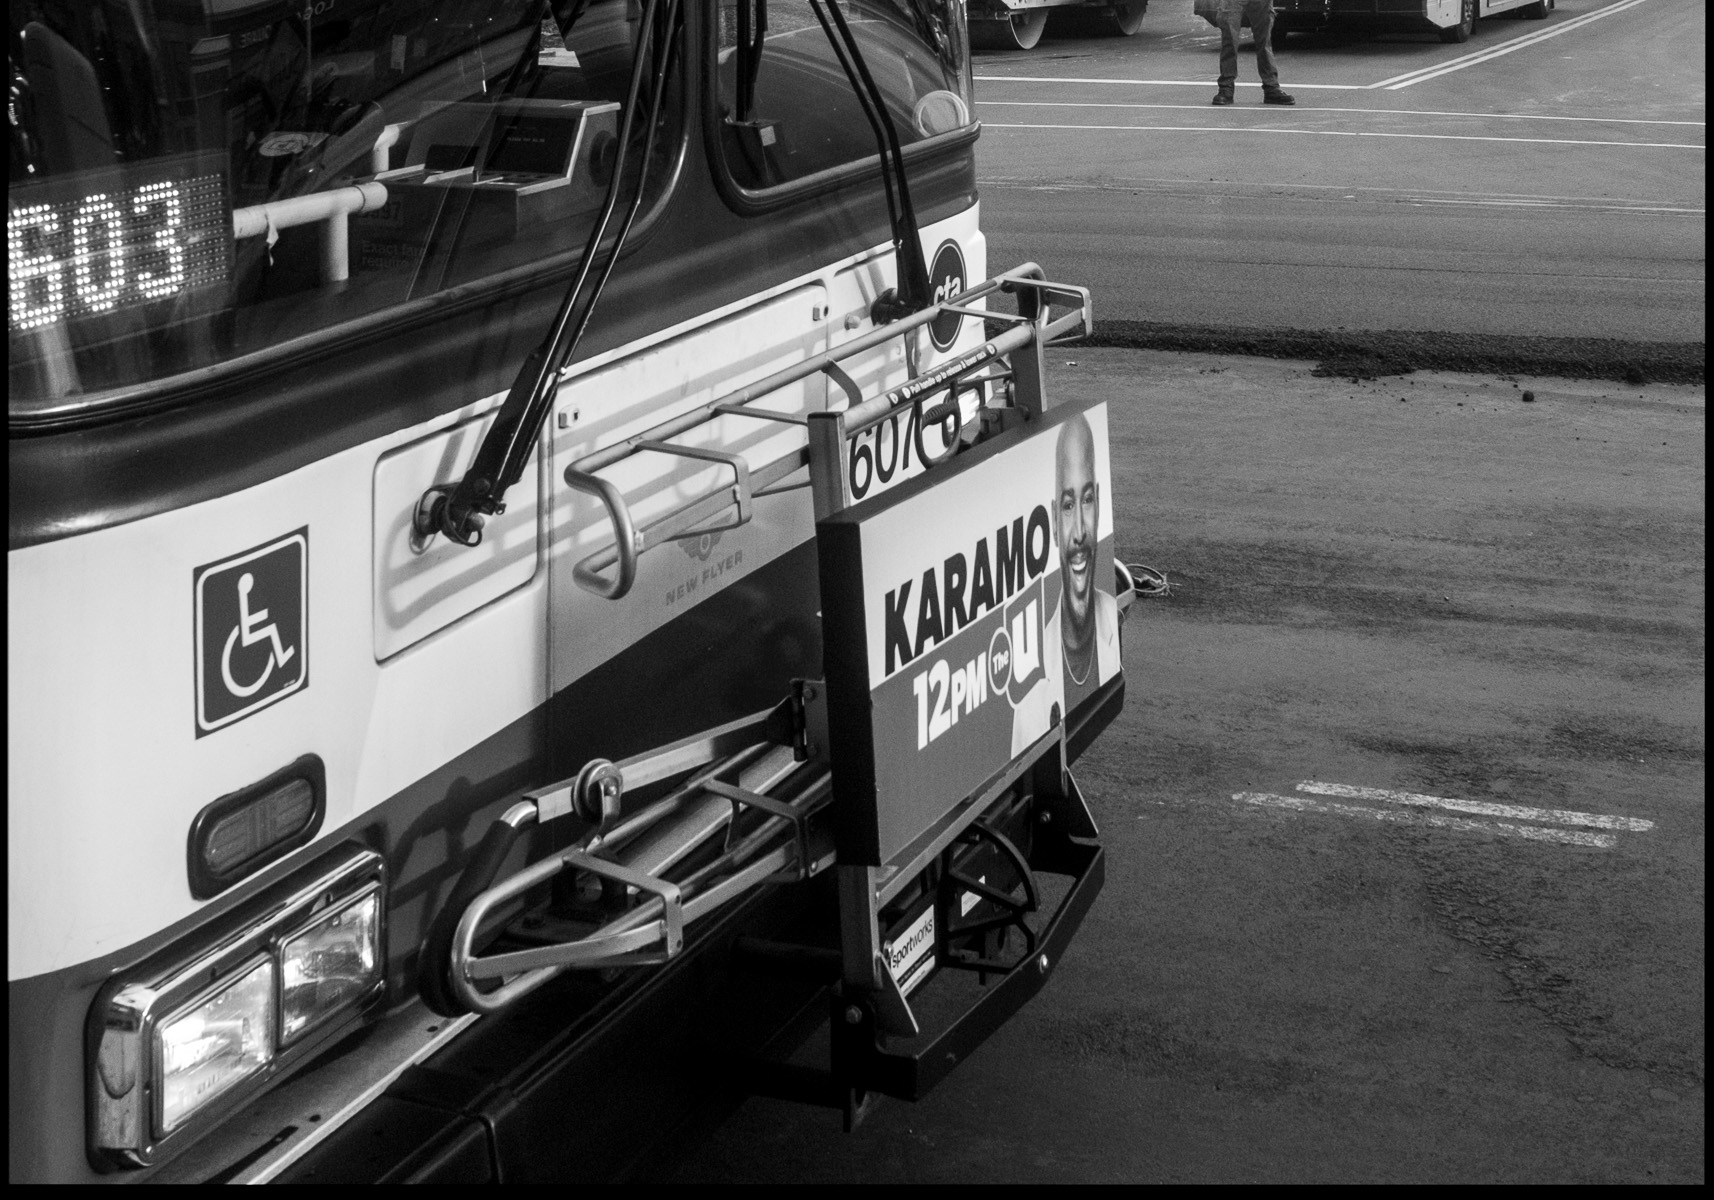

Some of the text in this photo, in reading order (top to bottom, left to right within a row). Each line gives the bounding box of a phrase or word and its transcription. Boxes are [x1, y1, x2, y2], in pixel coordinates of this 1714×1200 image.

[7, 182, 184, 330] 603
[666, 550, 743, 606] NEW FLYER
[885, 504, 1050, 678] KARAMO
[913, 651, 987, 751] 12PM
[992, 648, 1009, 675] The
[892, 918, 933, 969] sportworks
